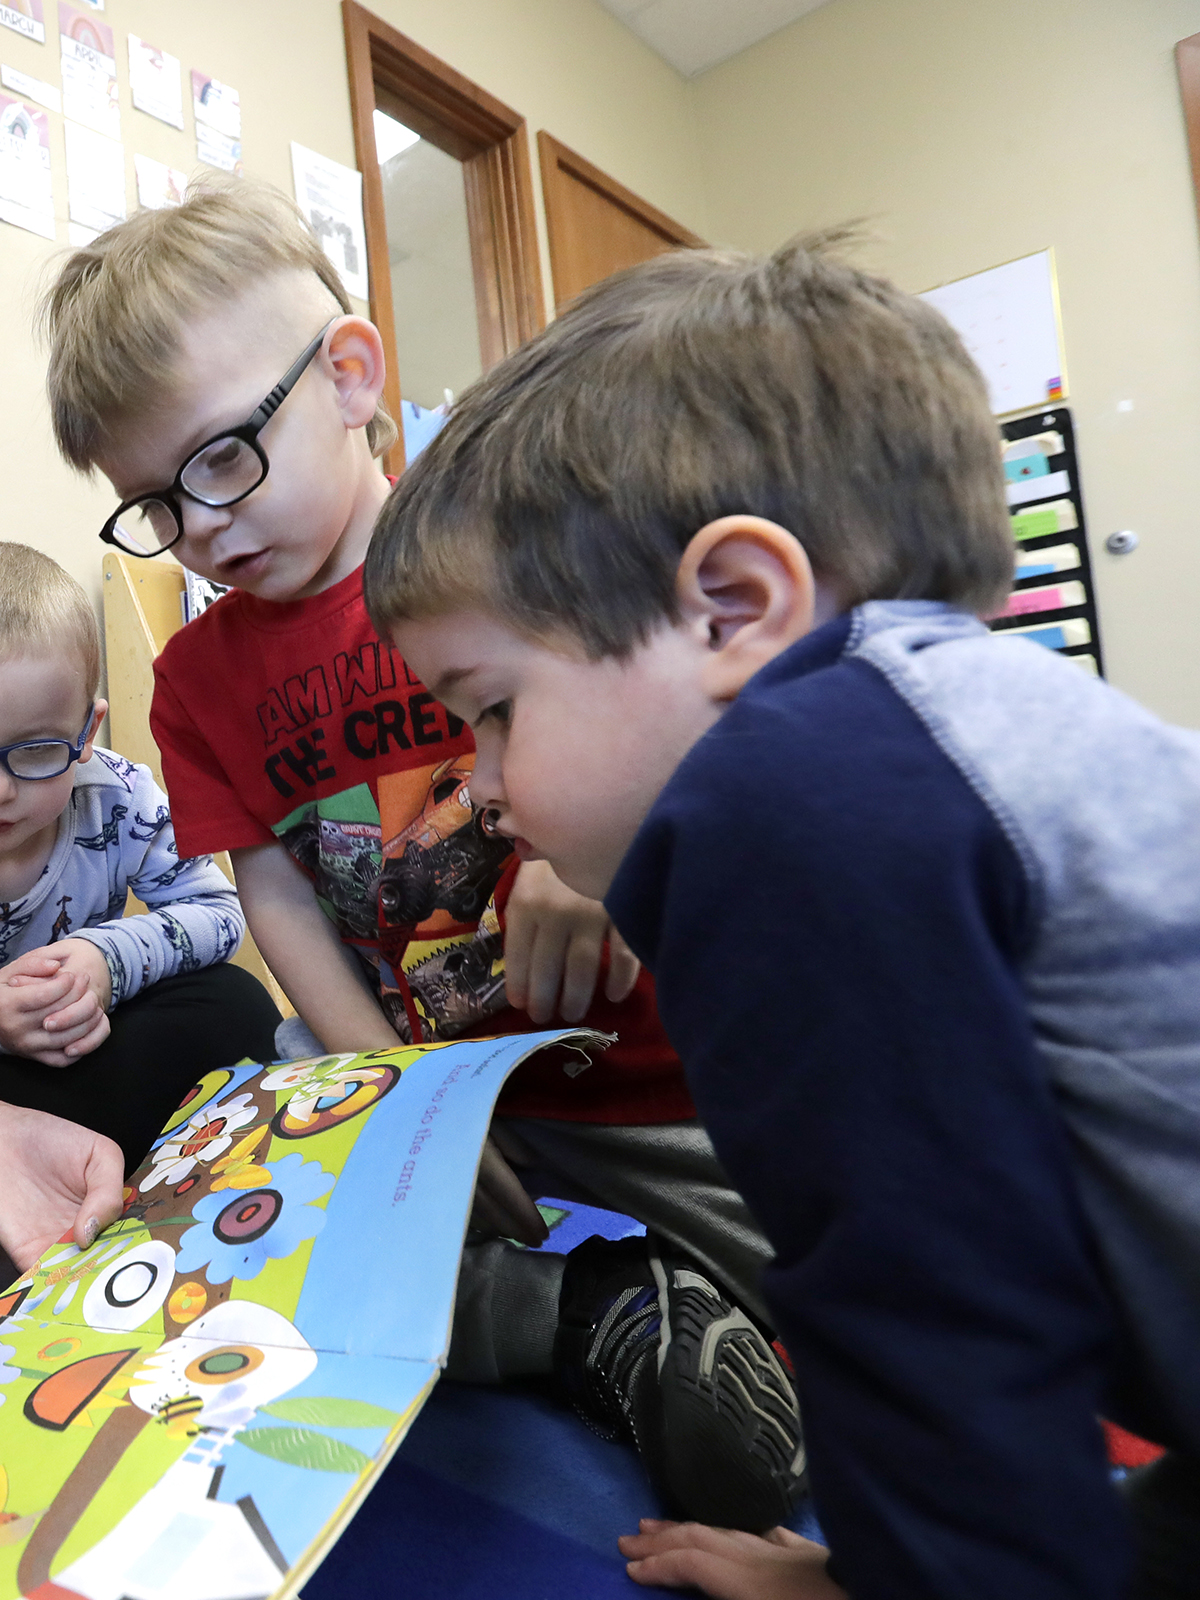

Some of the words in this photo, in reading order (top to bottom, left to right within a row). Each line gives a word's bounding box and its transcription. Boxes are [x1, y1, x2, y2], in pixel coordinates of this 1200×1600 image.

[74, 43, 104, 68] APRIL
[256, 664, 333, 749] AM
[432, 1086, 449, 1102] so
[421, 1105, 442, 1125] do
[409, 1128, 432, 1155] the
[391, 1160, 416, 1207] ants.
